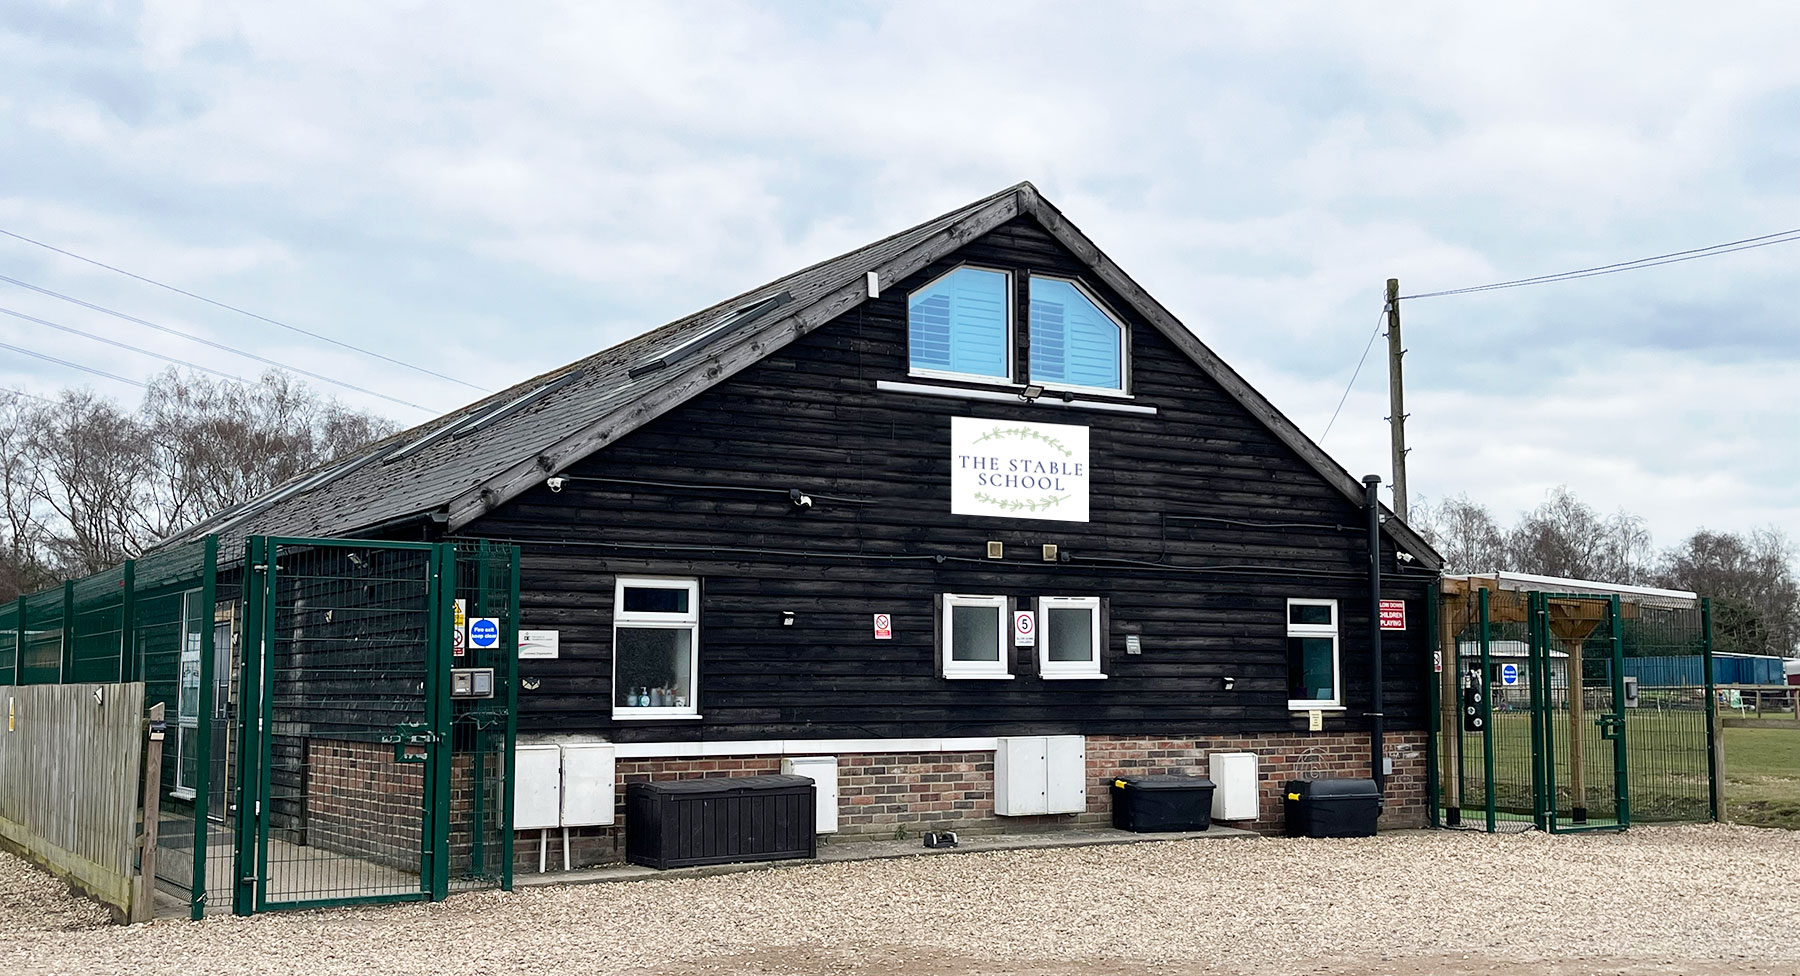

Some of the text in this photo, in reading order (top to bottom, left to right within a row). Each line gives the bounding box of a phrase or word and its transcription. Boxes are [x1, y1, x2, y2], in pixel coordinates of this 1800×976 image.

[959, 455, 1083, 476] THE STABLE
[978, 472, 1065, 491] SCHOOL
[1021, 619, 1028, 629] 5
